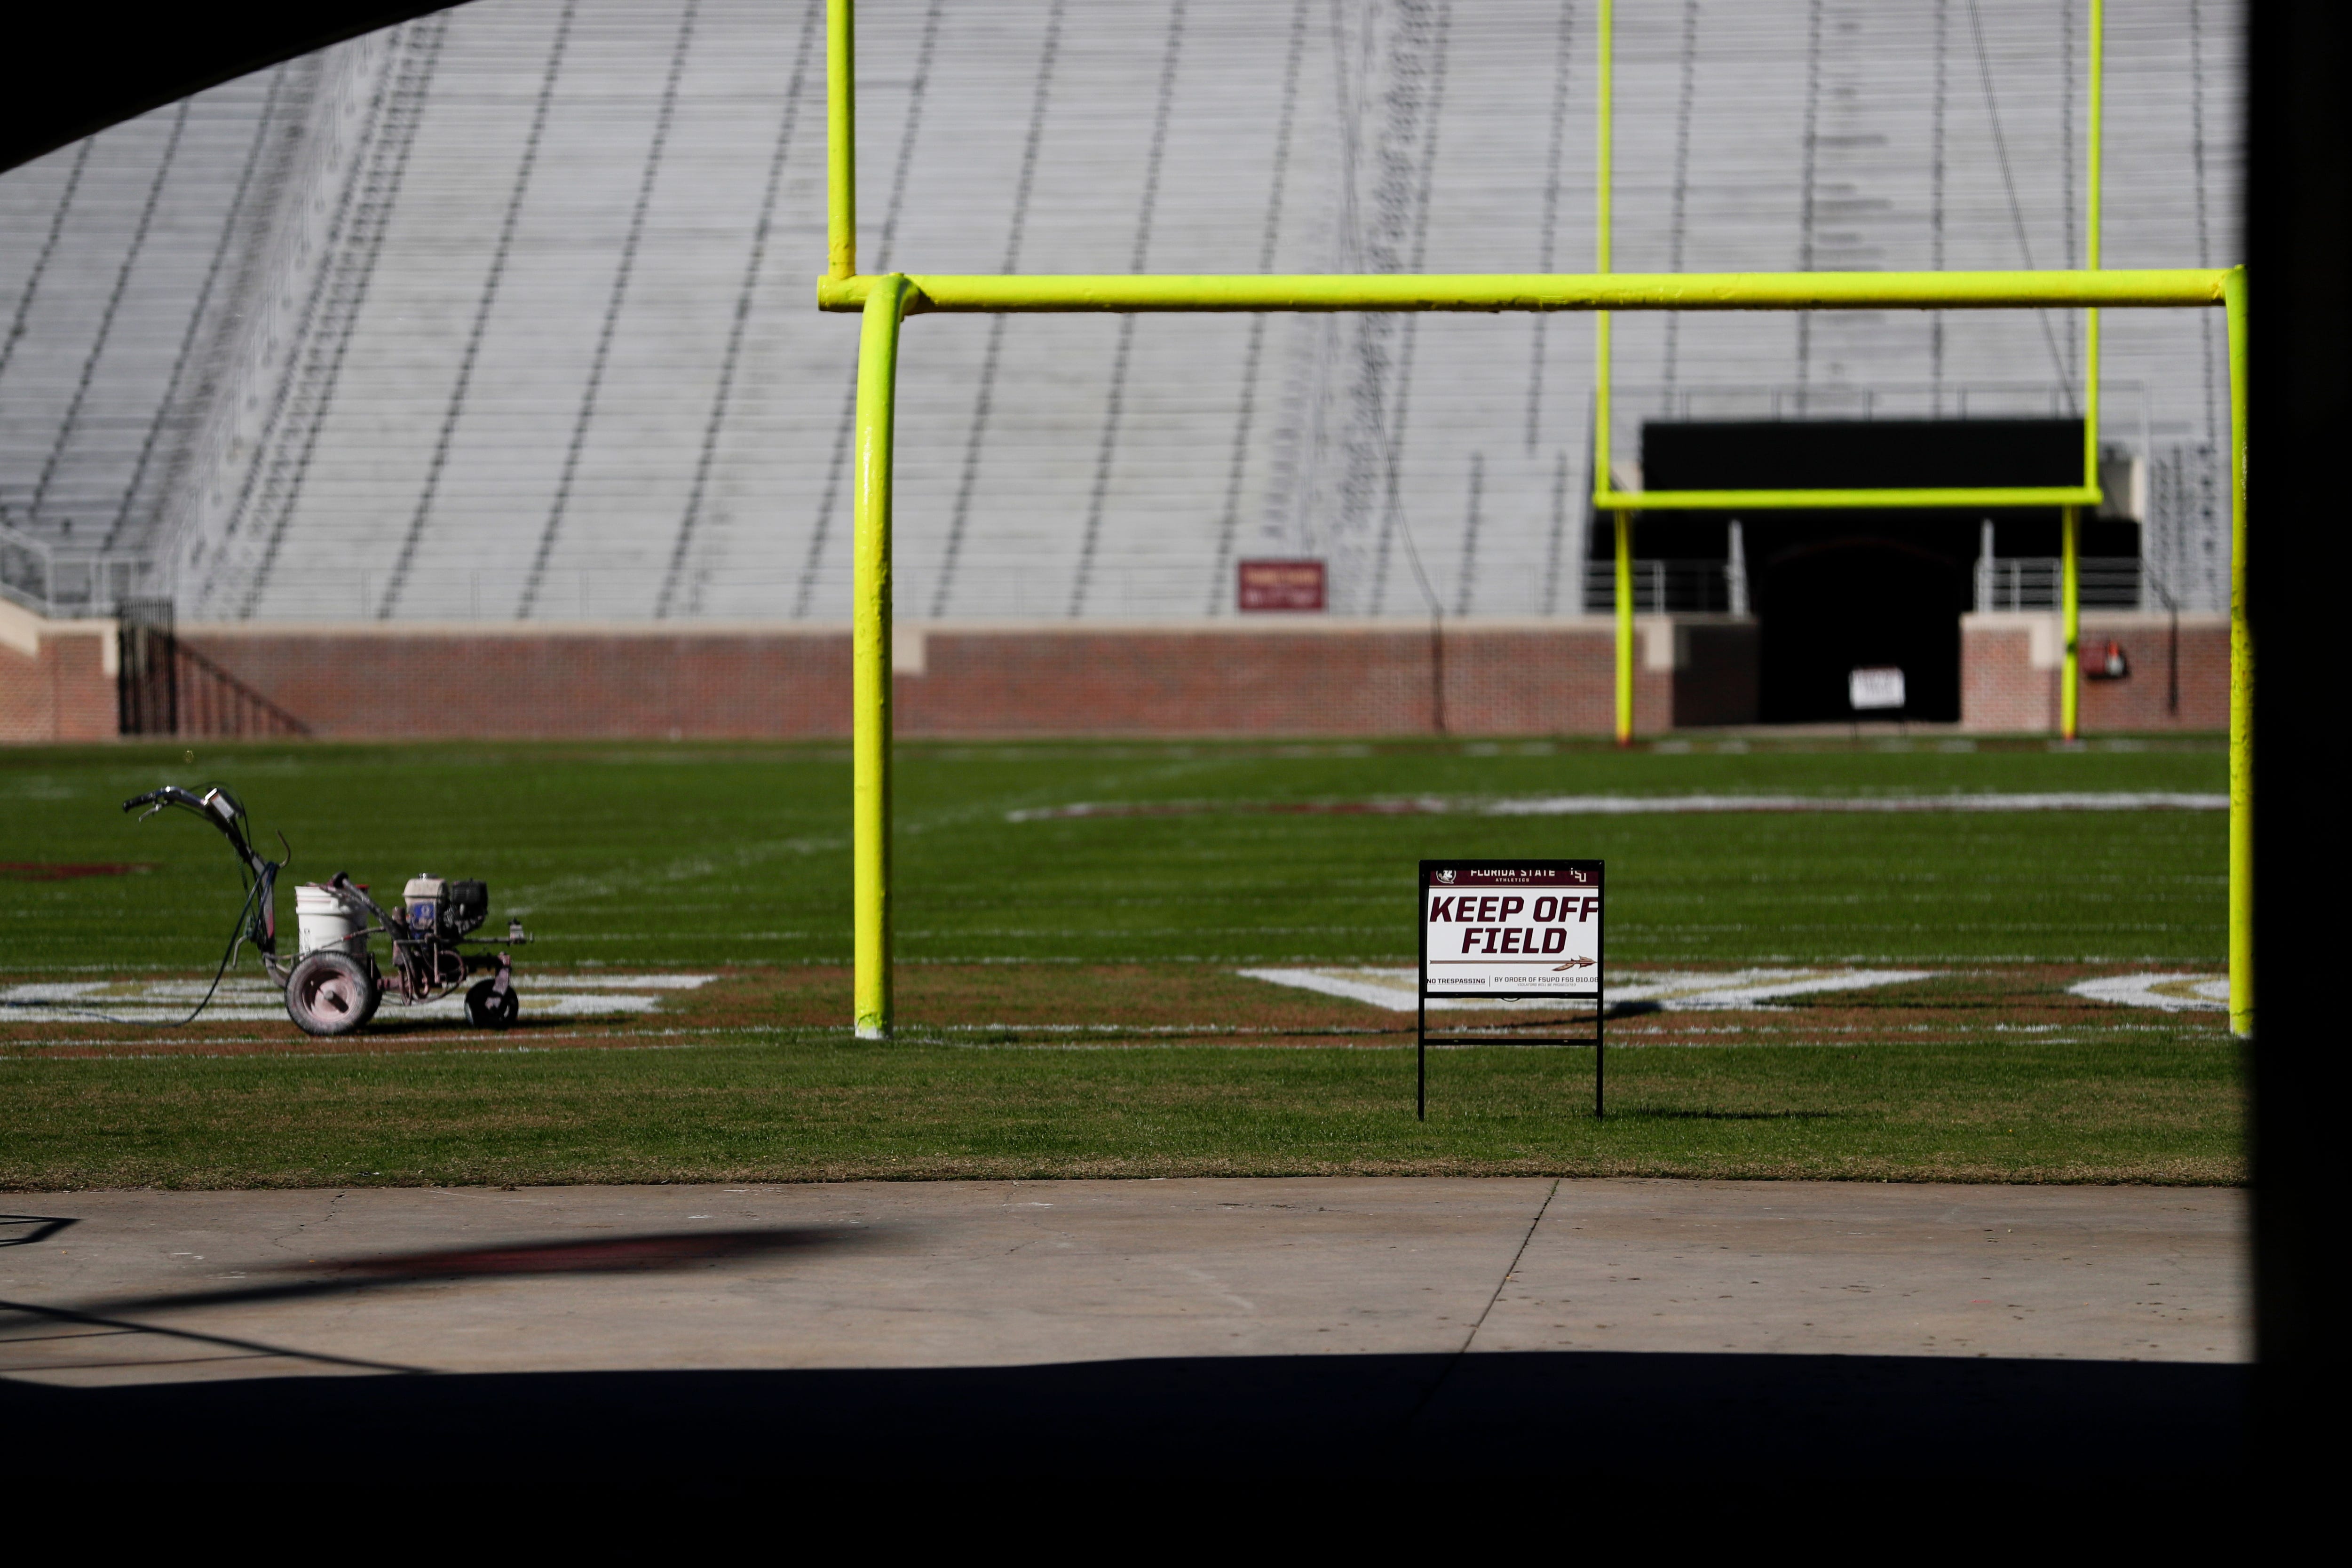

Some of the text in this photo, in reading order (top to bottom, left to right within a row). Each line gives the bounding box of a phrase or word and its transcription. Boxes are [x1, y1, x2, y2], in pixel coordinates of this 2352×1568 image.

[1430, 896, 1598, 922] KEEP OFF
[1461, 928, 1567, 953] FIELD
